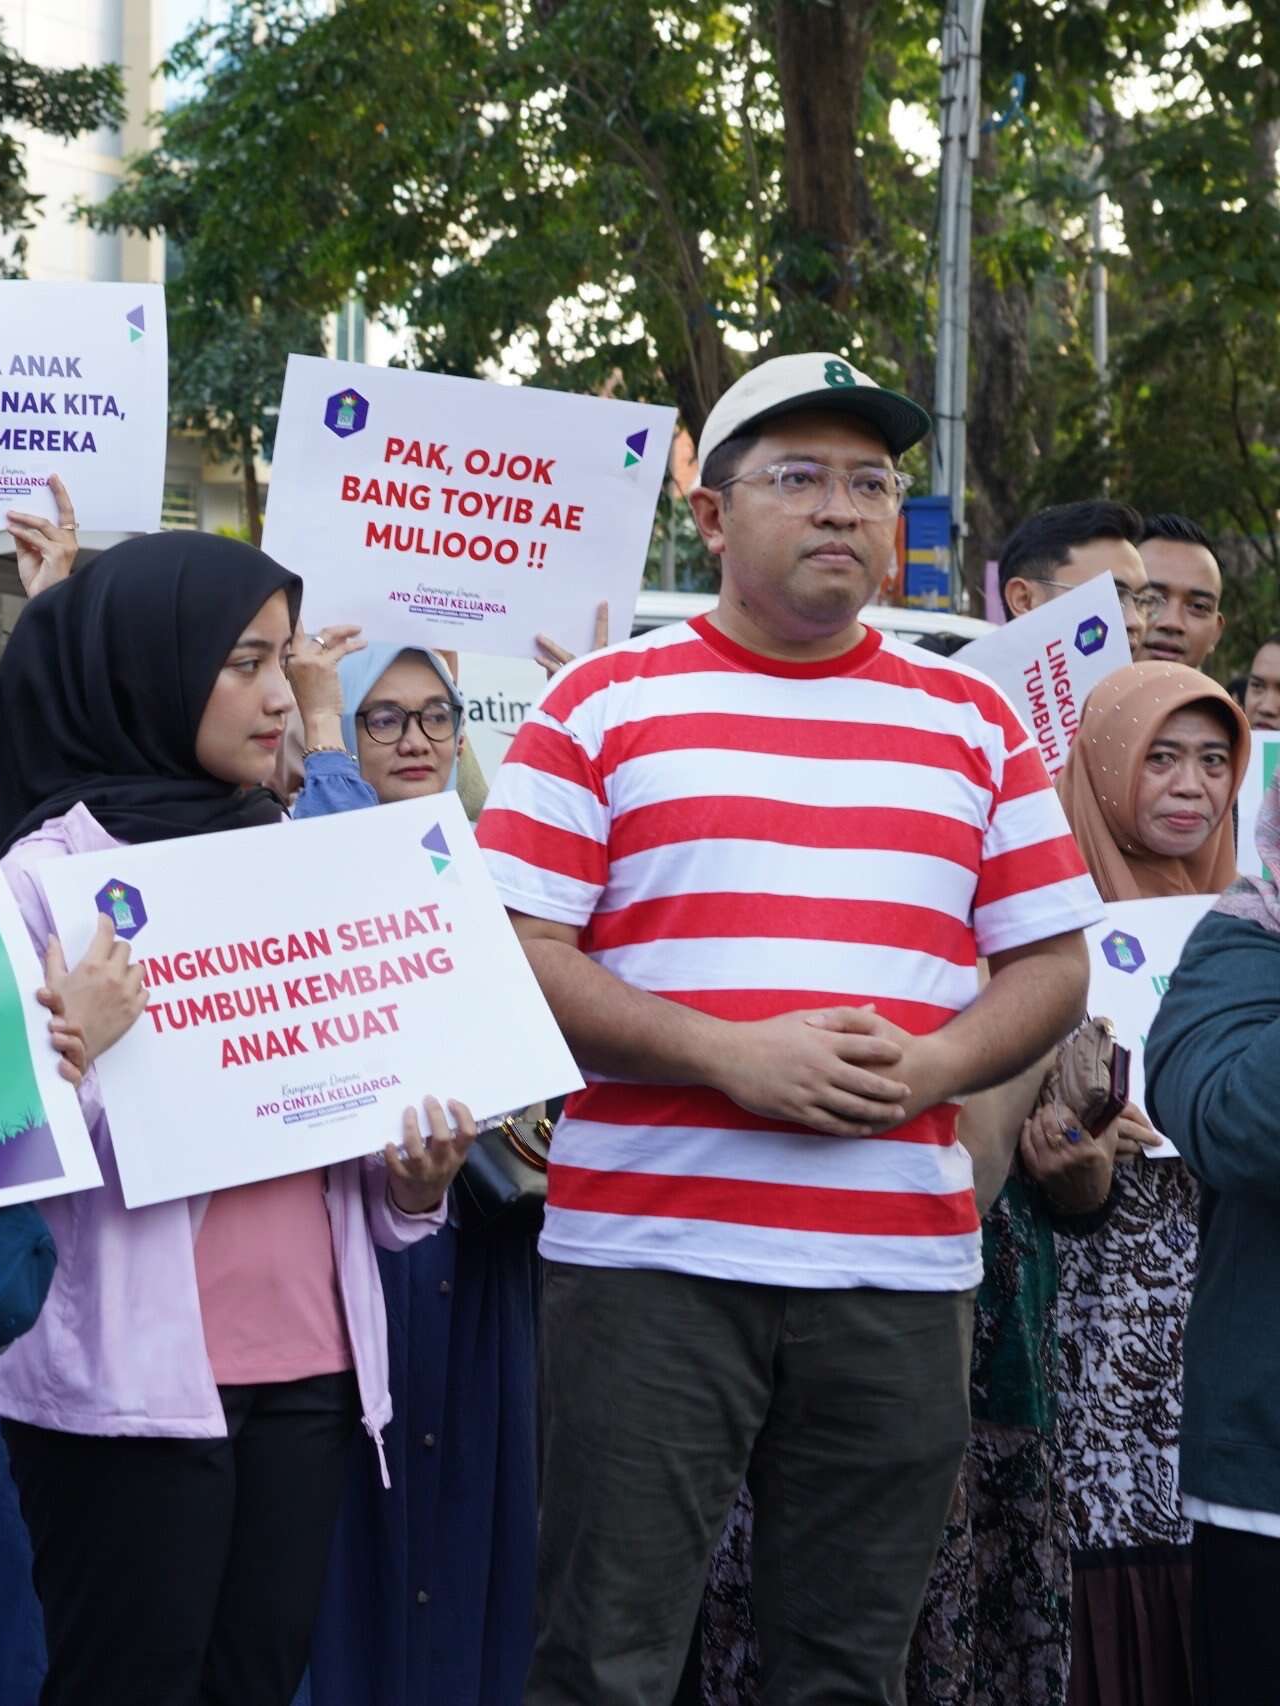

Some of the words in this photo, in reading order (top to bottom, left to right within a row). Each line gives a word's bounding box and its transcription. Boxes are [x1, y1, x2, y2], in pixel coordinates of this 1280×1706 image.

[9, 354, 82, 378] ANAK
[824, 360, 857, 388] 8
[64, 393, 126, 420] KITA,
[384, 437, 454, 476] PAK,
[464, 449, 556, 485] OJOK
[341, 475, 432, 512] BANG
[441, 488, 533, 524] TOYIB
[540, 502, 585, 532] AE
[365, 521, 519, 565] MULIOOO
[527, 541, 548, 569] !!
[389, 591, 411, 603] AYO
[414, 594, 448, 607] CINTAI
[450, 599, 507, 614] KELUARGA
[1023, 660, 1061, 762] TUMBUH
[138, 929, 332, 988] INGKUNGAN
[336, 903, 453, 953] SEHAT,
[145, 983, 280, 1034] TUMBUH
[283, 947, 454, 1009] KEMBANG
[221, 1024, 309, 1070] ANAK
[311, 1003, 401, 1050] KUAT
[256, 1102, 280, 1118] AYO
[282, 1092, 326, 1112] CINTAI
[327, 1074, 401, 1101] KELUARGA
